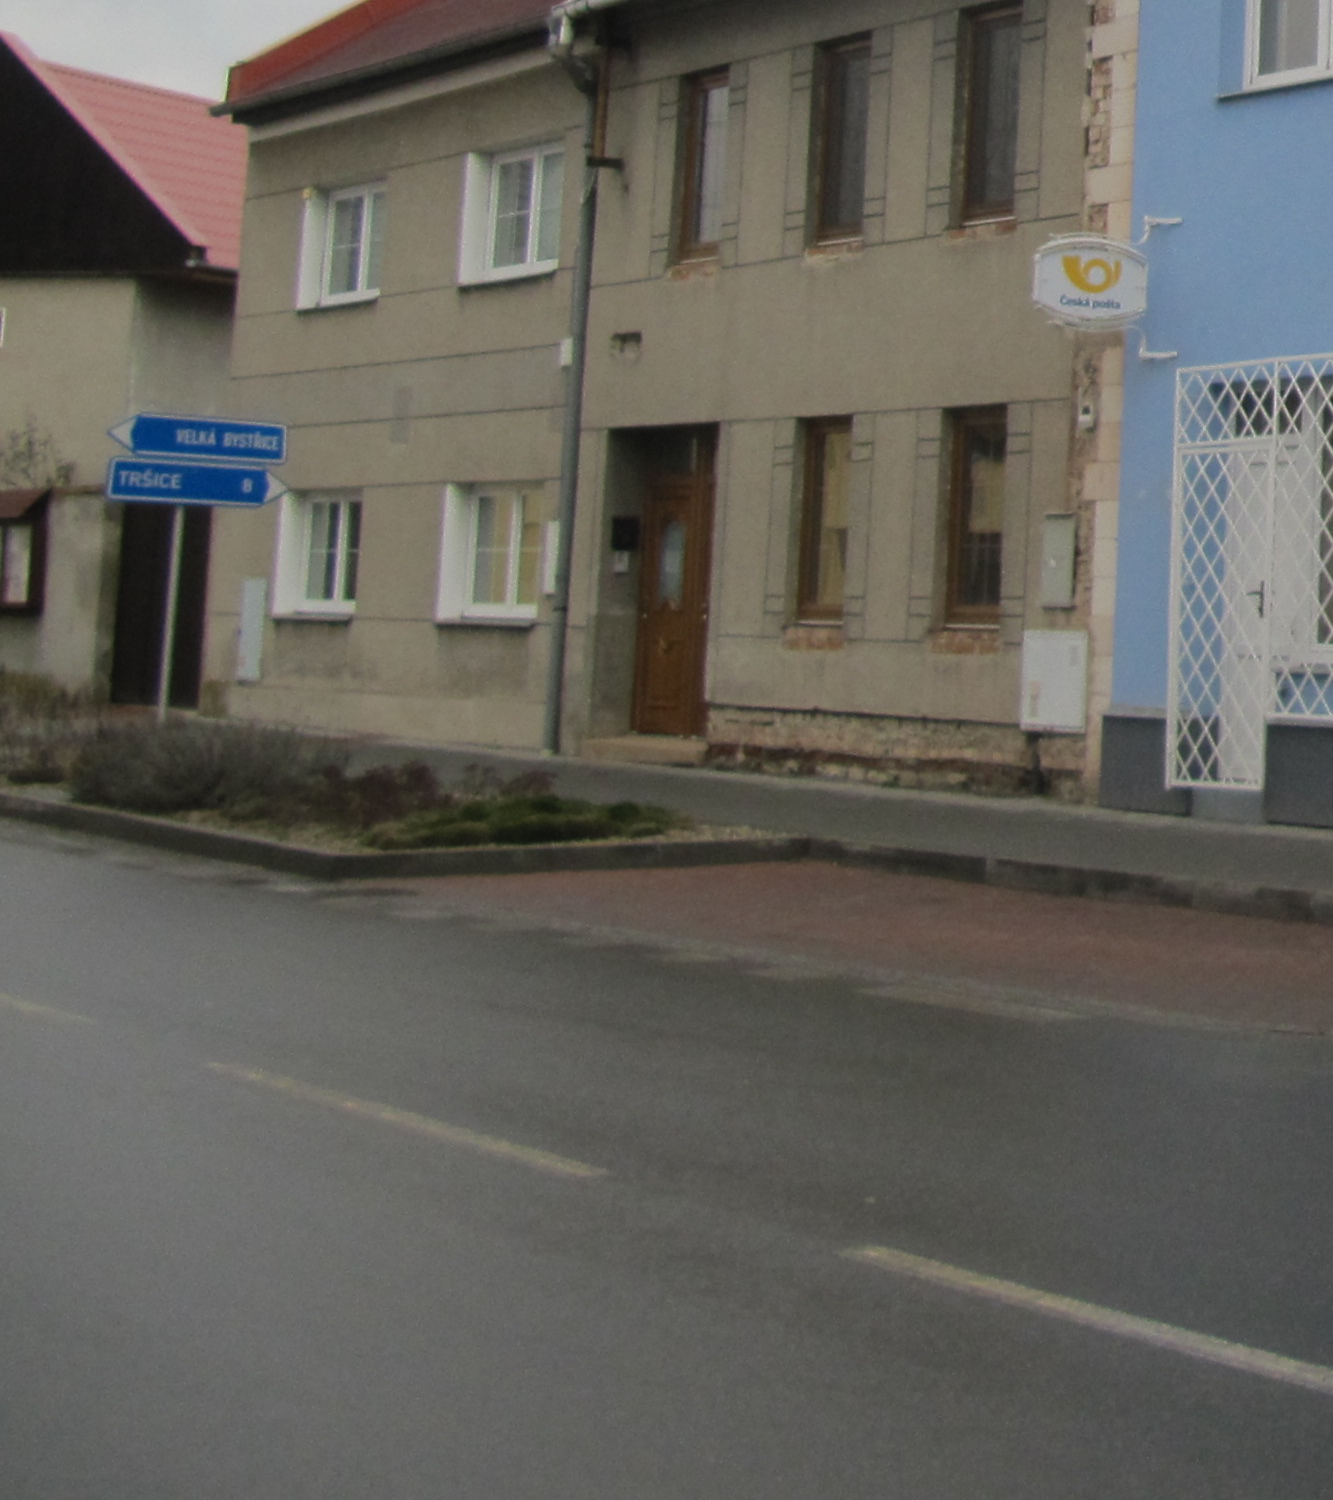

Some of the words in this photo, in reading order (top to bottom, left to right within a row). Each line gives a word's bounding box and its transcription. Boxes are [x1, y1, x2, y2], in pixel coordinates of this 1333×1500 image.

[1060, 295, 1090, 306] Česká
[1093, 298, 1121, 309] pošta
[176, 428, 216, 445] VELKÁ
[223, 431, 279, 450] BYSTŘICE
[120, 469, 182, 489] TRŠICE
